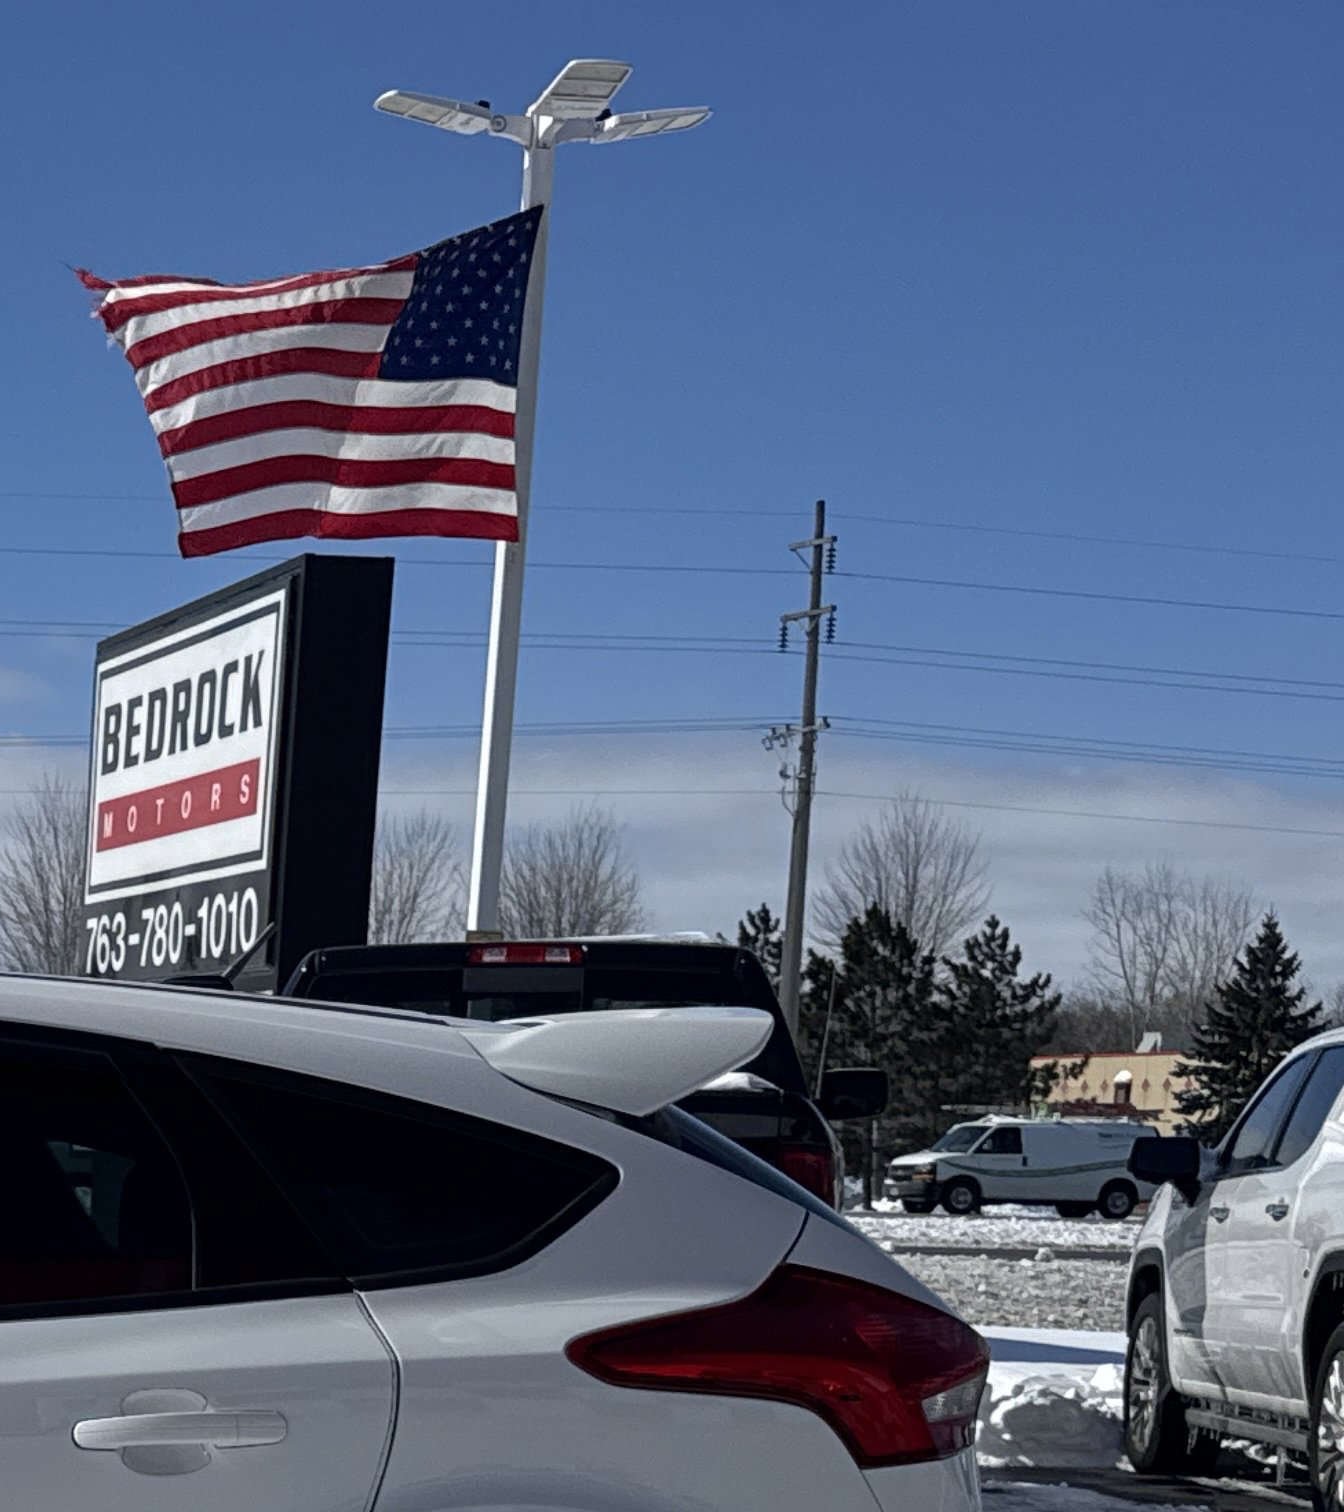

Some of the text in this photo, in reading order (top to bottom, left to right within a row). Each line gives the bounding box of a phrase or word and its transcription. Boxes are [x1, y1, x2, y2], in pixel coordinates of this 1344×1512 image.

[102, 650, 264, 775] BEDROCK
[103, 774, 251, 838] MOTORS
[86, 888, 258, 974] 763-780-1010
